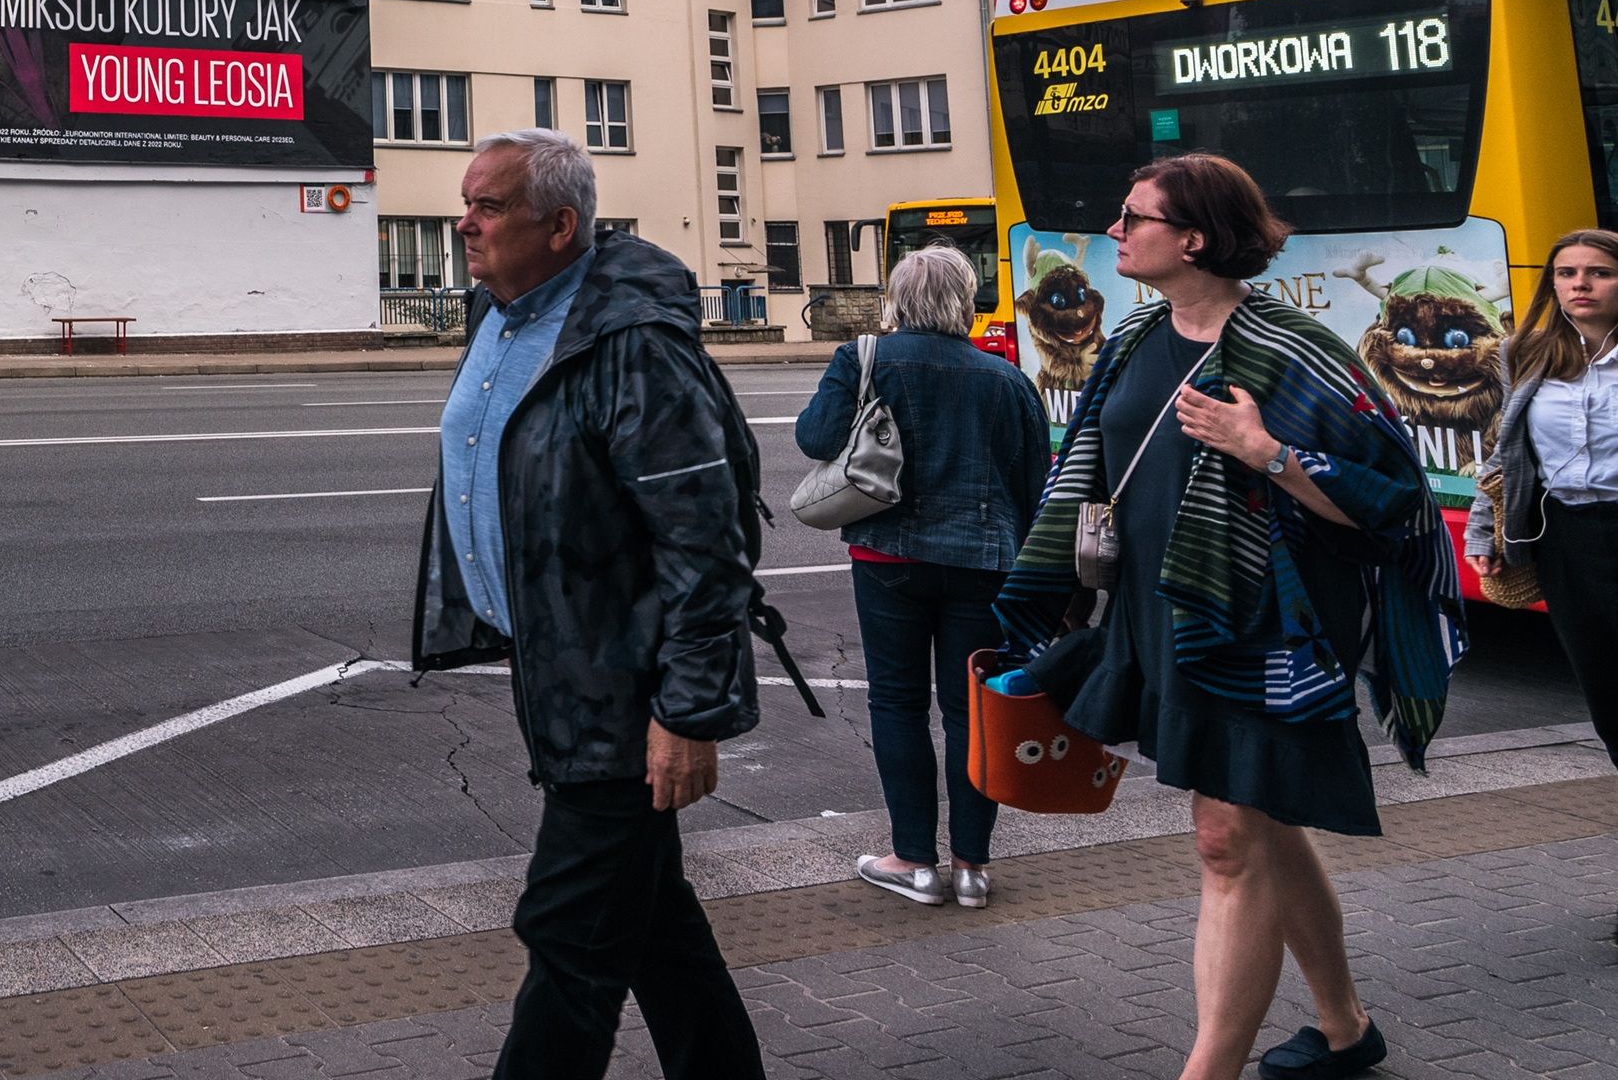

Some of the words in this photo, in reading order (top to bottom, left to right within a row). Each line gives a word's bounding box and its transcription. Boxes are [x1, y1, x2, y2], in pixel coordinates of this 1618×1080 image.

[1034, 43, 1107, 79] 4404
[1173, 31, 1353, 84] DWORKOWA
[1380, 18, 1449, 71] 118
[81, 54, 184, 104] YOUNG
[194, 60, 293, 108] LEOSIA
[1067, 93, 1109, 113] mza
